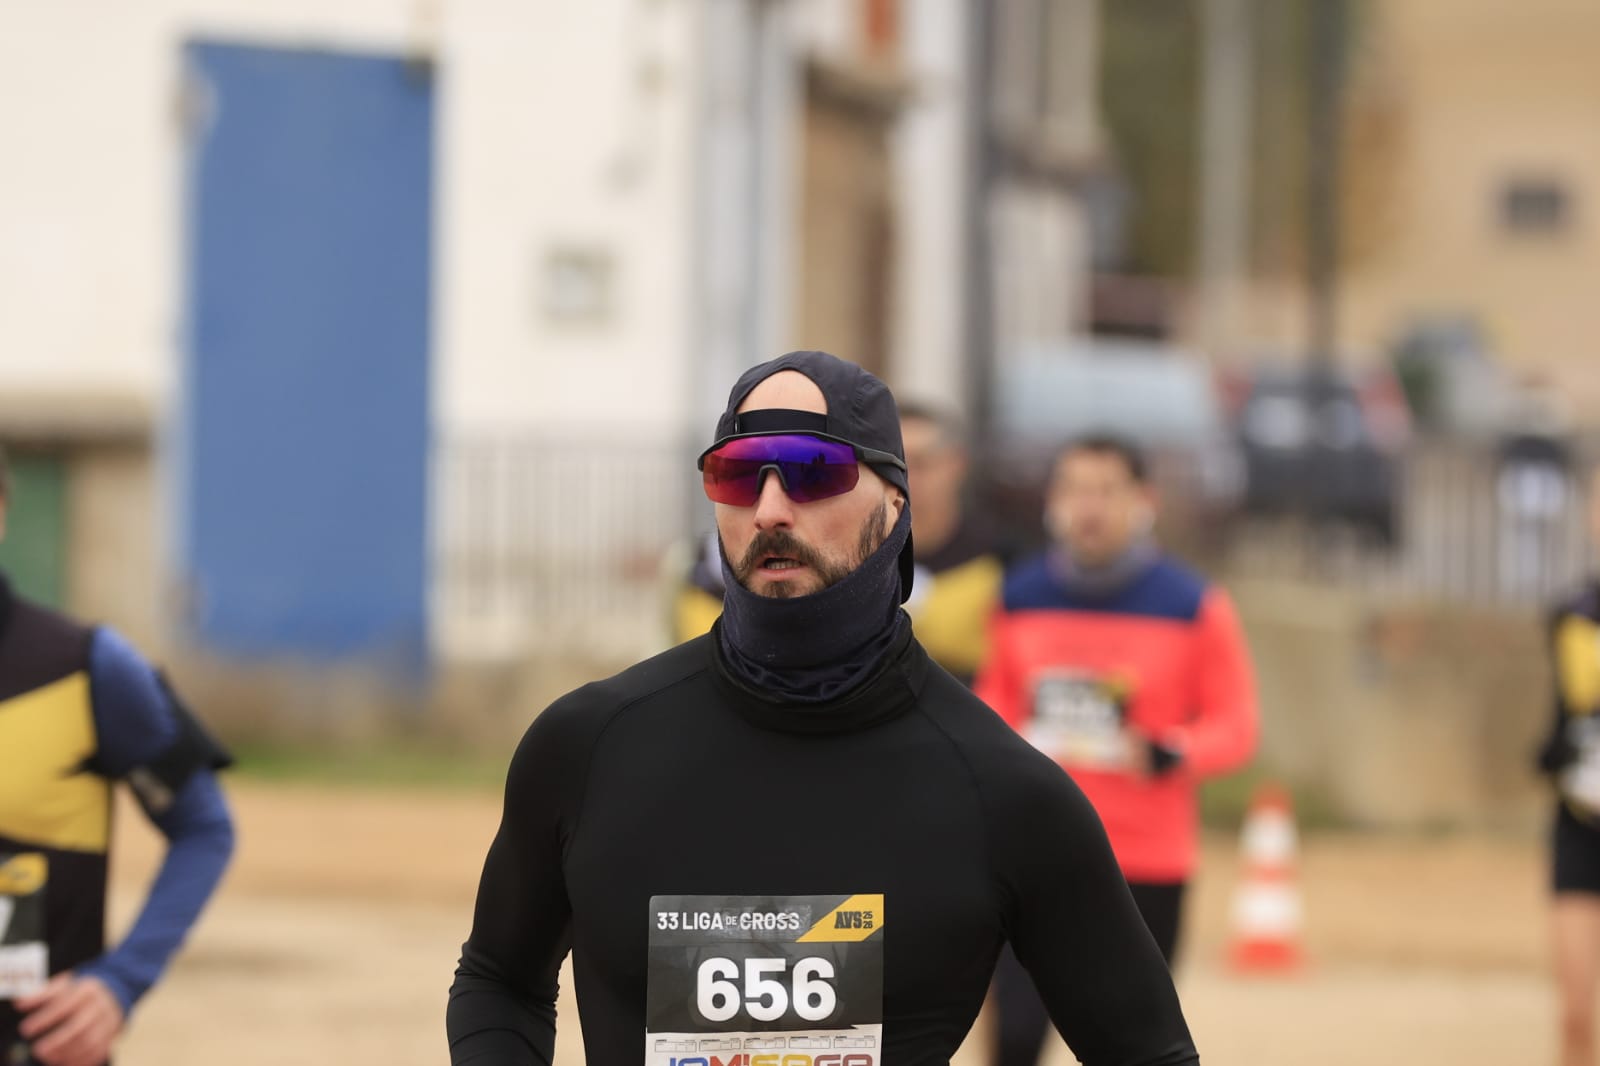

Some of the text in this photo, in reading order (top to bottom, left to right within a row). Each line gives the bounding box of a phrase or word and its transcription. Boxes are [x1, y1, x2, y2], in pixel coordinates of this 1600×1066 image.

[657, 912, 800, 930] 33 LIGA DE CROSS
[834, 911, 873, 928] AVS 25
[697, 957, 836, 1021] 656
